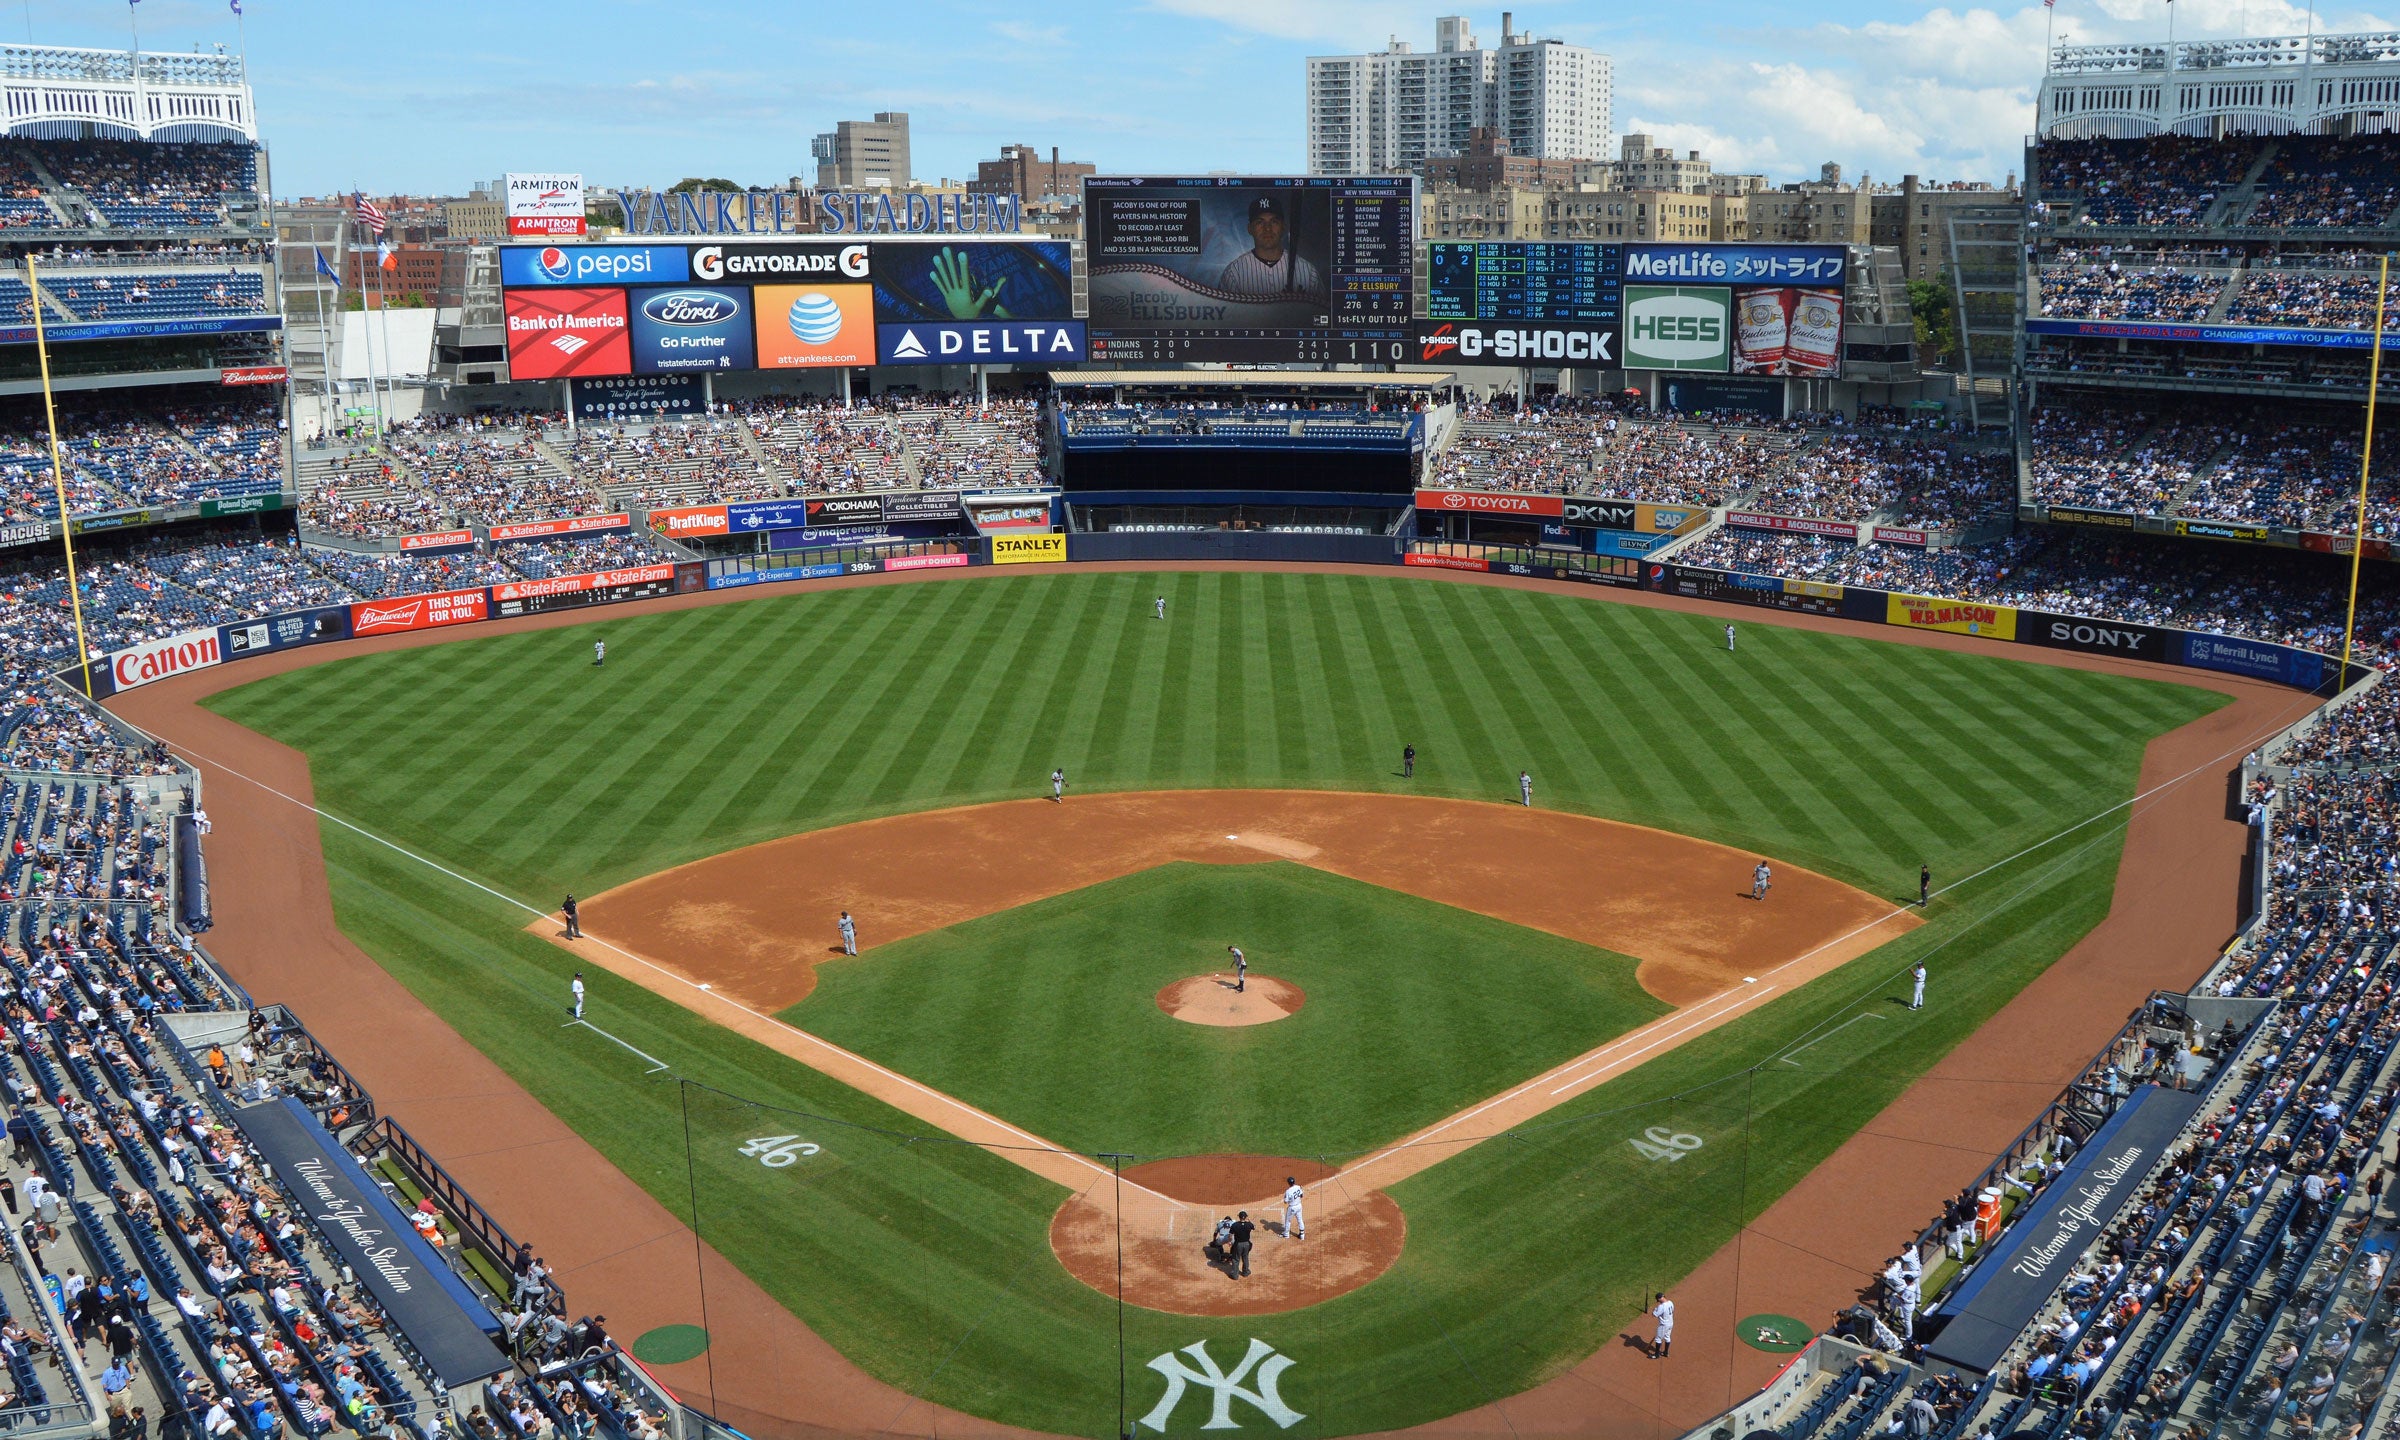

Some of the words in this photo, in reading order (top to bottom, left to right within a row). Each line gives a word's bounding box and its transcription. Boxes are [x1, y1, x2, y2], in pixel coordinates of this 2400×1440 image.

[511, 181, 578, 189] ARMITRON
[616, 192, 795, 234] YANKEE
[822, 193, 1022, 233] STADIUM
[517, 219, 577, 228] ARMITRON
[577, 250, 652, 278] pepsi
[727, 255, 836, 272] GATORADE
[1436, 255, 1443, 265] 0
[1461, 255, 1468, 265] 2
[1626, 251, 1727, 277] MetLife
[1734, 256, 1843, 278] メットライフ
[1130, 292, 1179, 305] Jacoby
[662, 296, 719, 320] Ford
[1131, 306, 1226, 320] ELLSBURY
[47, 328, 92, 337] CHANGING
[94, 327, 109, 335] THE
[112, 326, 131, 334] WAY
[134, 325, 151, 333] YOU
[155, 324, 170, 332] BUY
[181, 322, 222, 330] MATTRESS
[510, 316, 547, 330] Bank
[548, 315, 565, 329] of
[565, 314, 624, 328] America
[1634, 315, 1720, 342] HESS
[2100, 326, 2159, 337] RICHARD
[2162, 328, 2169, 337] &
[2173, 329, 2199, 338] SON
[2204, 330, 2254, 340] CHANGING
[2257, 331, 2274, 341] THE
[2277, 333, 2298, 342] WAY
[2301, 333, 2321, 343] YOU
[2324, 334, 2343, 343] BUY
[2355, 336, 2400, 346] MATRESS
[661, 337, 678, 348] Go
[681, 336, 725, 347] Further
[940, 328, 1074, 354] DELTA
[1420, 336, 1458, 345] G-SHOCK
[1460, 329, 1612, 360] G-SHOCK
[1109, 351, 1143, 359] YANKEES
[1349, 343, 1355, 359] 1
[1371, 343, 1377, 359] 1
[1391, 343, 1403, 359] 0
[658, 359, 714, 367] tristateford.com
[778, 354, 856, 365] att.yankees.com
[223, 372, 286, 383] Budweiser
[625, 389, 639, 400] York
[641, 389, 664, 399] Yankees
[218, 500, 240, 511] Poland
[241, 498, 263, 509] Spring
[824, 501, 880, 511] YOKOHAMA
[896, 503, 947, 511] COLLECTIBLES
[1469, 496, 1530, 510] TOYOTA
[670, 514, 726, 529] DraftKings
[977, 511, 1011, 524] Peanut
[1012, 507, 1043, 519] Chews
[1565, 504, 1635, 524] DKNY
[1655, 512, 1682, 527] SAP
[2051, 510, 2073, 521] FOX
[2074, 513, 2132, 527] BUSINESS
[1545, 524, 1571, 536] FedEx
[1730, 514, 1771, 526] MODELL'S
[1788, 521, 1853, 536] MODELLS.com
[1878, 530, 1921, 542] MODELL'S
[996, 540, 1061, 551] STANLEY
[1628, 540, 1649, 550] LYNX
[896, 559, 927, 568] DUNKIN'
[767, 571, 793, 580] Experian
[812, 568, 837, 576] Experian
[726, 576, 750, 585] Experian
[1750, 578, 1772, 587] pepsi
[428, 599, 451, 609] THIS
[454, 594, 484, 606] BUD'S
[361, 609, 415, 625] Budweiser
[430, 610, 449, 622] FOR
[451, 607, 475, 619] YOU.
[277, 622, 303, 632] ON-FIELD
[252, 635, 266, 644] ERA
[2051, 622, 2145, 649] SONY
[116, 636, 219, 686] Canon
[2214, 644, 2246, 658] Merrill
[2250, 649, 2278, 664] Lynch
[738, 1135, 820, 1167] 46
[1629, 1127, 1702, 1161] 46
[2094, 1147, 2143, 1185] Stadium
[294, 1158, 336, 1200] Welcome
[325, 1198, 349, 1209] to
[2059, 1184, 2111, 1226] Yankee
[318, 1206, 383, 1246] Yankee
[2058, 1220, 2080, 1231] to
[2013, 1230, 2072, 1277] Welcome
[364, 1247, 411, 1293] Stadium
